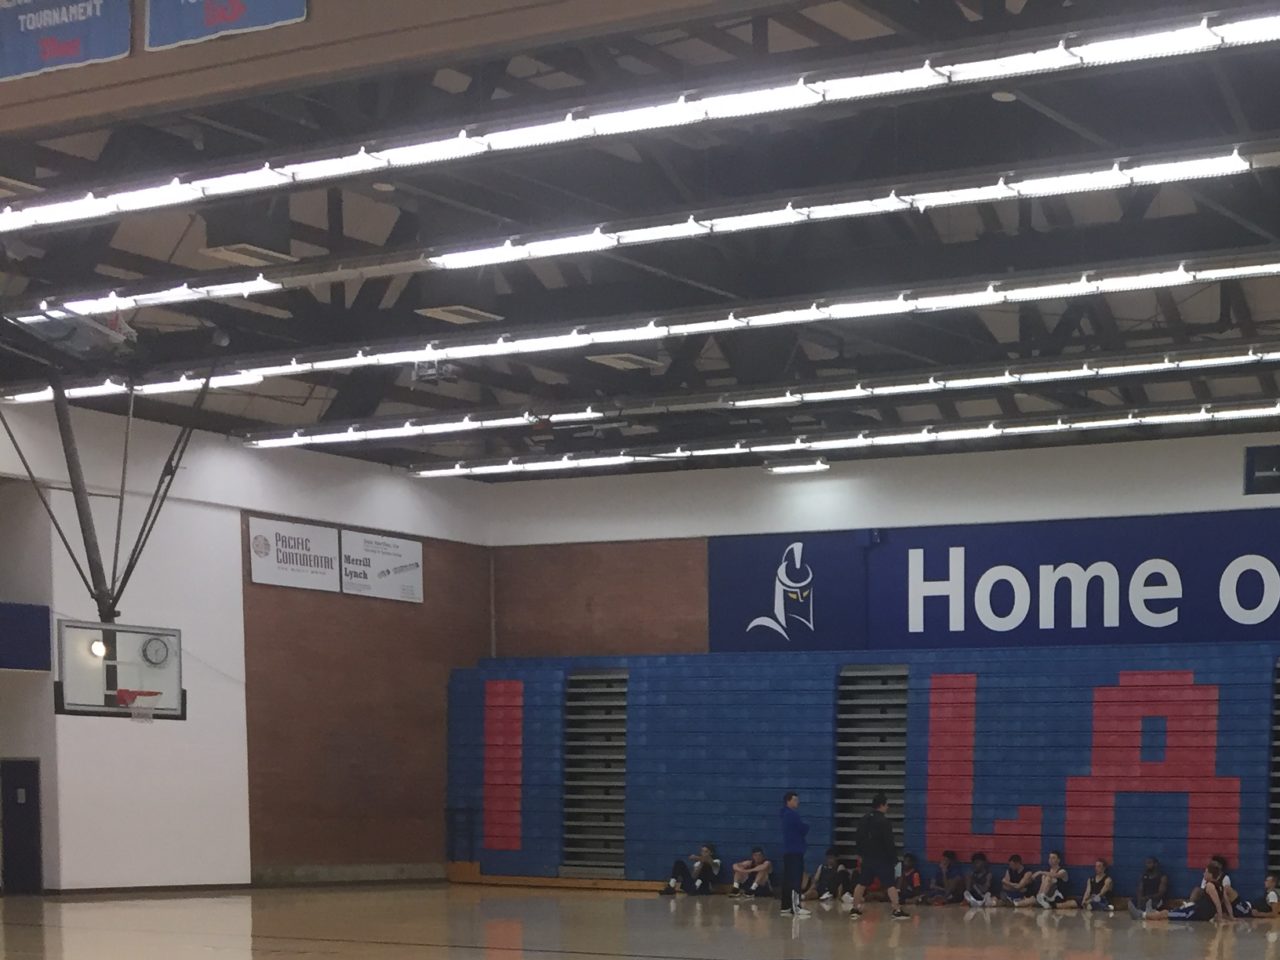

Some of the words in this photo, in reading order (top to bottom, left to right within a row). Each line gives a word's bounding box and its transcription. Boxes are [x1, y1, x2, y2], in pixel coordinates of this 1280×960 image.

[18, 0, 103, 32] TOURNAMENT
[343, 554, 371, 567] Merrill
[344, 567, 368, 580] Lynch
[908, 547, 1182, 633] Home
